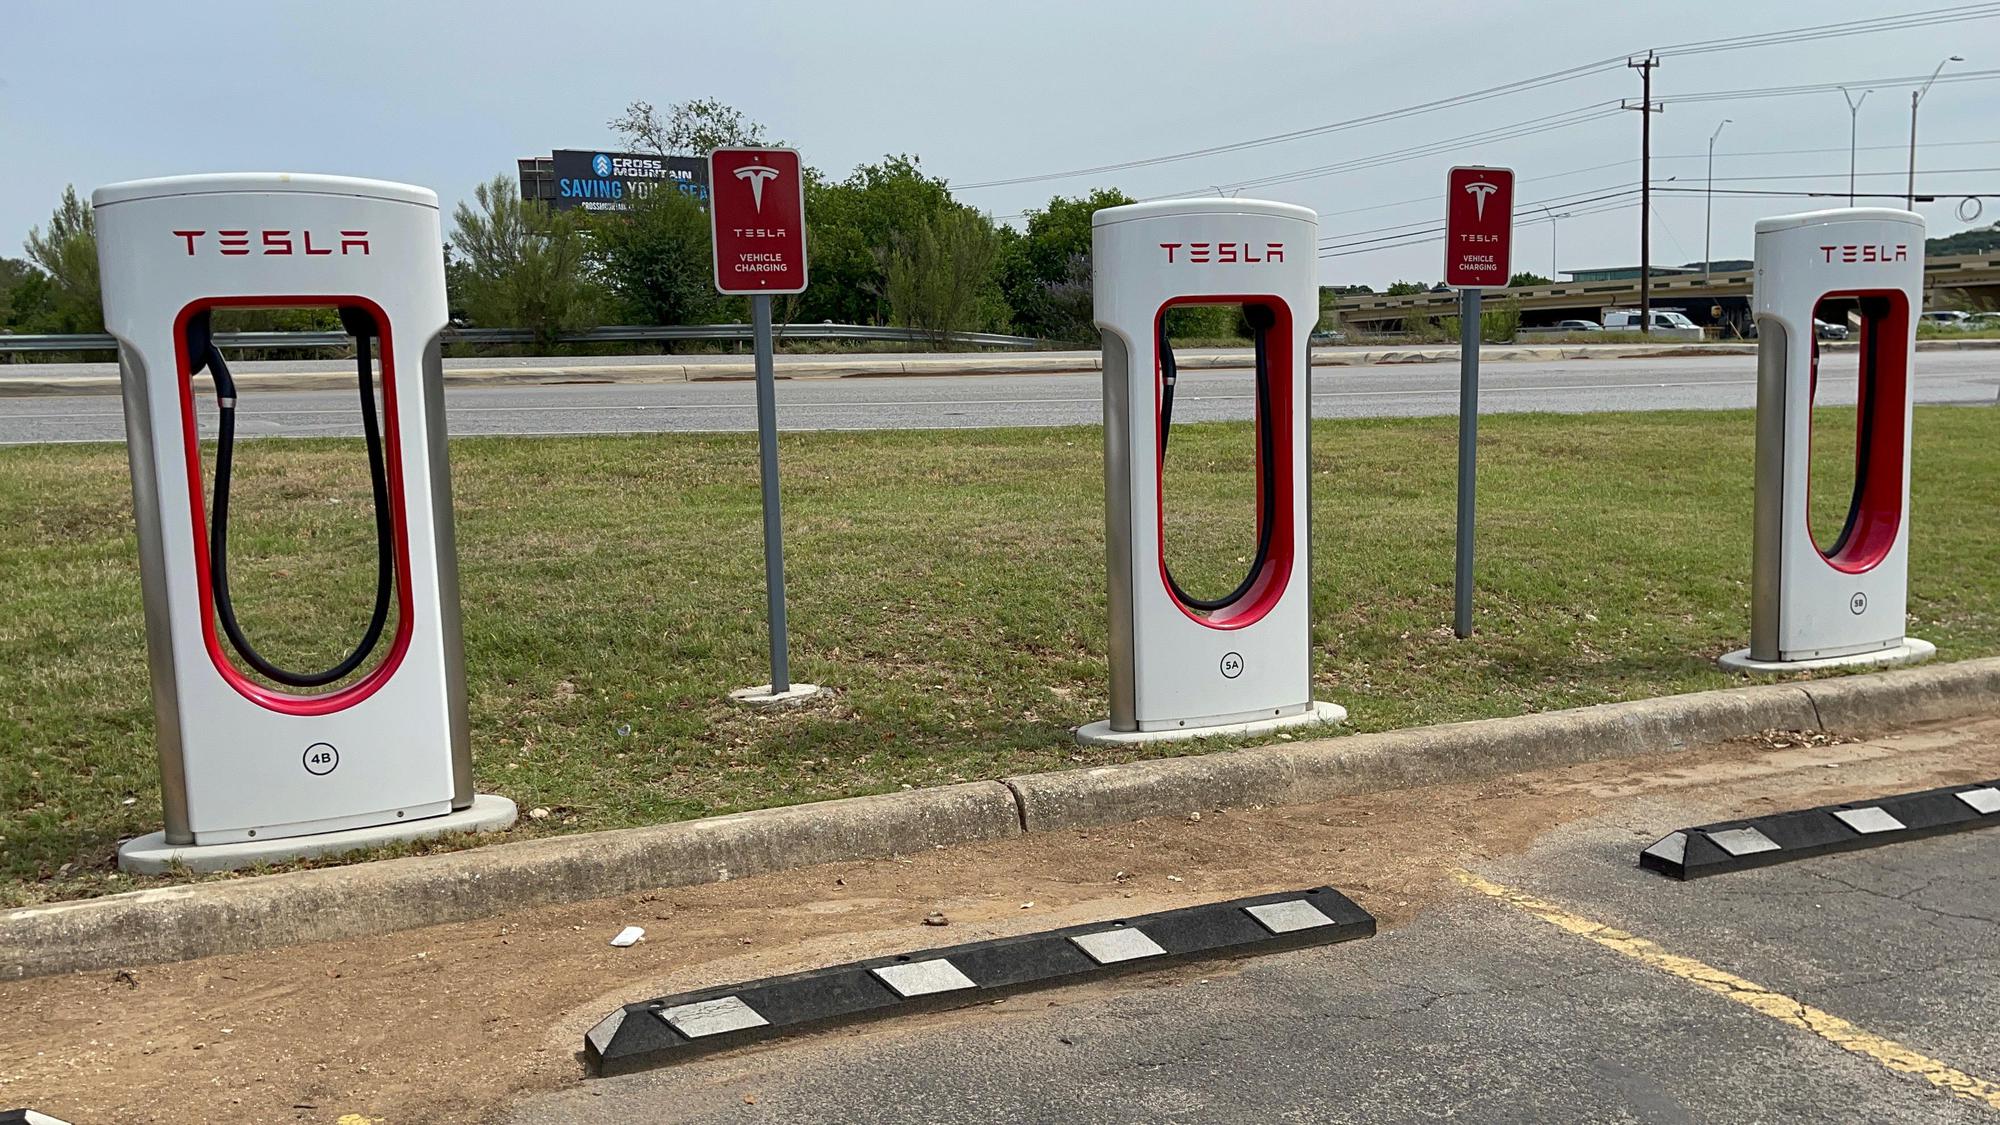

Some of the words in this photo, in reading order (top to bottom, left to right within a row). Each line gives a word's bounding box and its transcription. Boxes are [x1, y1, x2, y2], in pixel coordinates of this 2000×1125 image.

[612, 158, 661, 169] CROSS
[612, 167, 692, 179] MOUNTAIN
[560, 178, 622, 199] SAVING
[679, 183, 709, 200] SEA
[733, 228, 786, 238] TESLA
[1460, 234, 1499, 242] TESLA
[172, 230, 370, 256] TESLA
[739, 253, 782, 262] VEHICLE
[1159, 242, 1284, 264] TESLA
[1819, 245, 1907, 263] TESLA
[1463, 255, 1494, 263] VEHICLE
[734, 263, 788, 272] CHARGING
[1458, 263, 1498, 271] CHARGING
[1225, 660, 1239, 670] 5A
[310, 752, 332, 764] 4B
